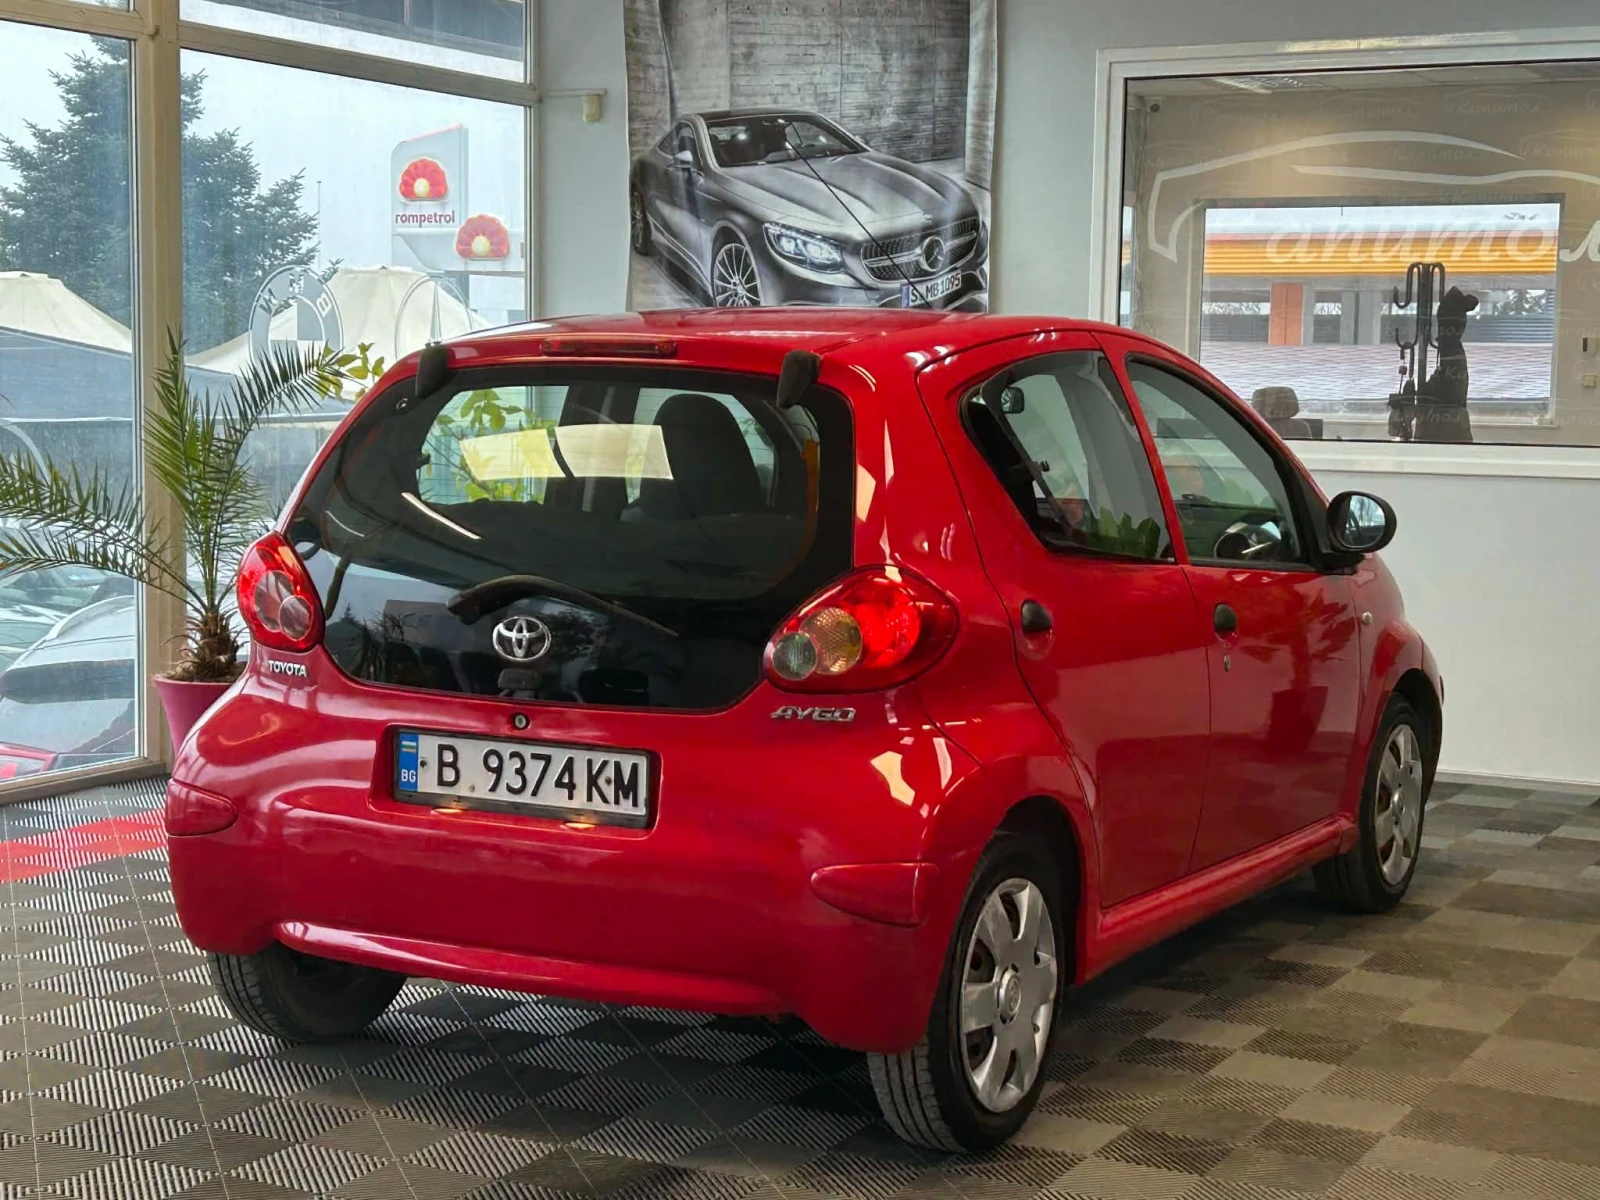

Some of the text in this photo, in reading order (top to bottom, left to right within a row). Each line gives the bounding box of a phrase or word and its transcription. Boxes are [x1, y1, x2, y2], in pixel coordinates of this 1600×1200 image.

[395, 210, 455, 228] rompetrol
[268, 660, 307, 678] TOYOTA
[770, 705, 856, 722] AYGO
[401, 768, 416, 783] BG
[436, 743, 639, 808] B 9374 KM
